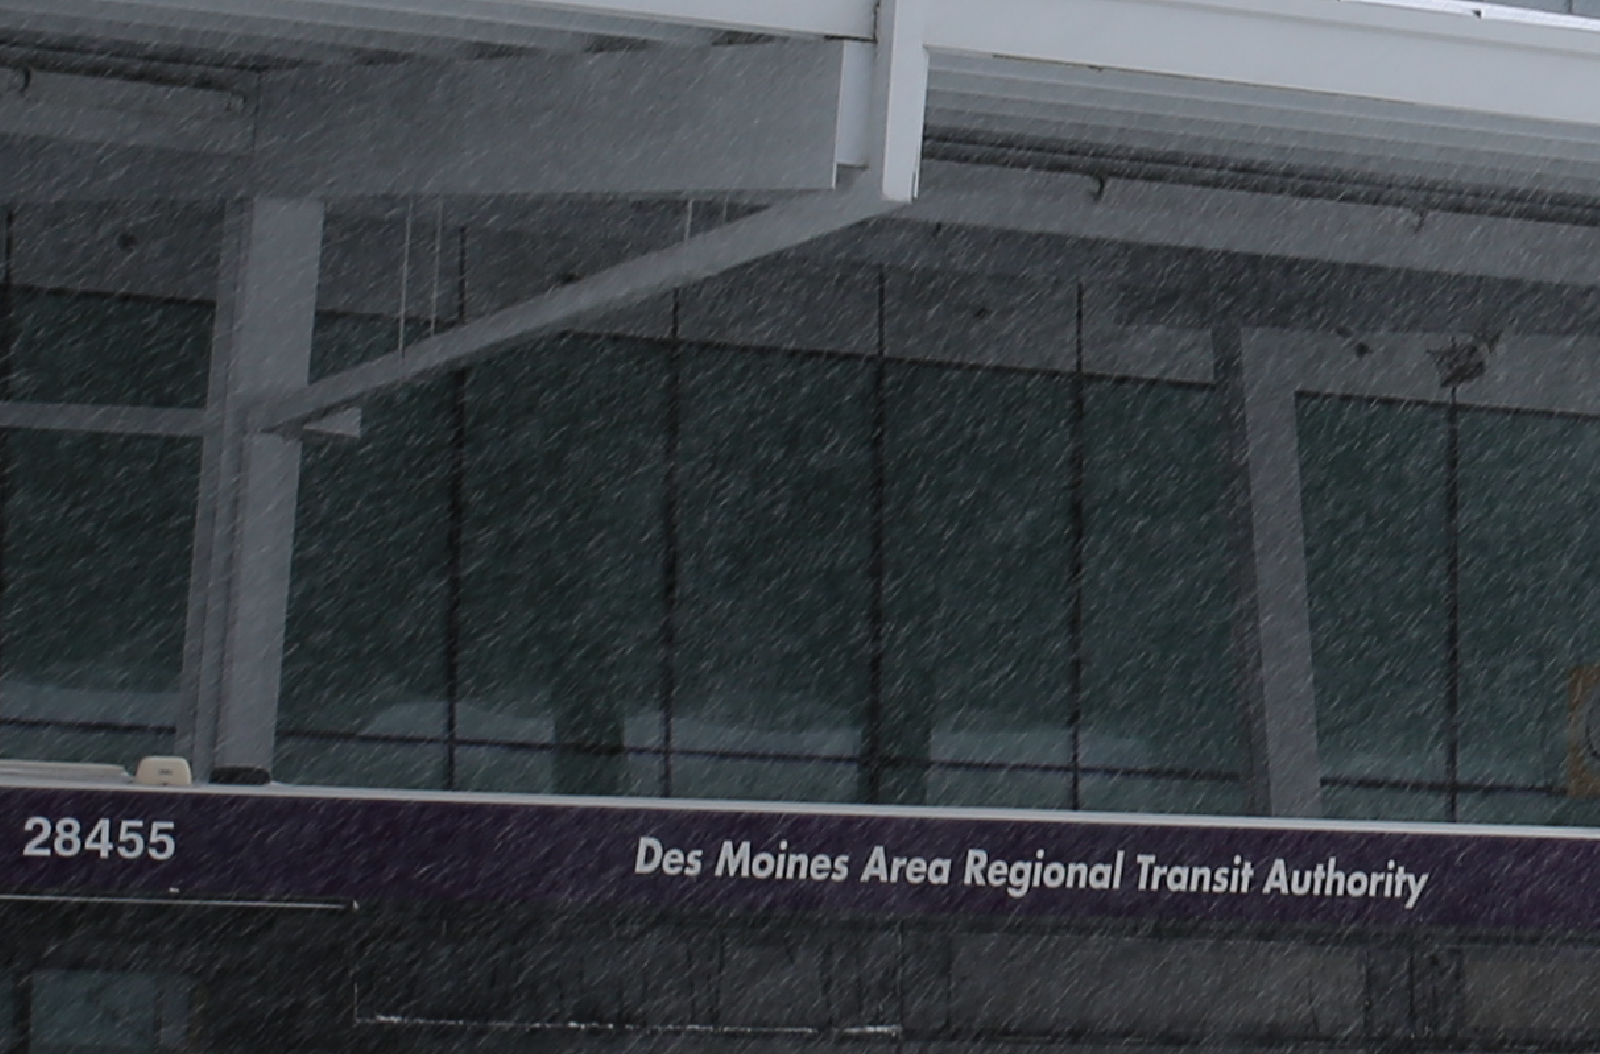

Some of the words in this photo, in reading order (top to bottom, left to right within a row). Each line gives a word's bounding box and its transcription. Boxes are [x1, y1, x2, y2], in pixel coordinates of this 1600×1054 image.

[22, 816, 176, 861] 28455
[634, 836, 704, 876] Des
[714, 839, 850, 880] Moines
[859, 845, 952, 885] Area
[963, 849, 1126, 898] Regional
[1136, 853, 1255, 894] Transit
[1262, 856, 1430, 910] Authority
